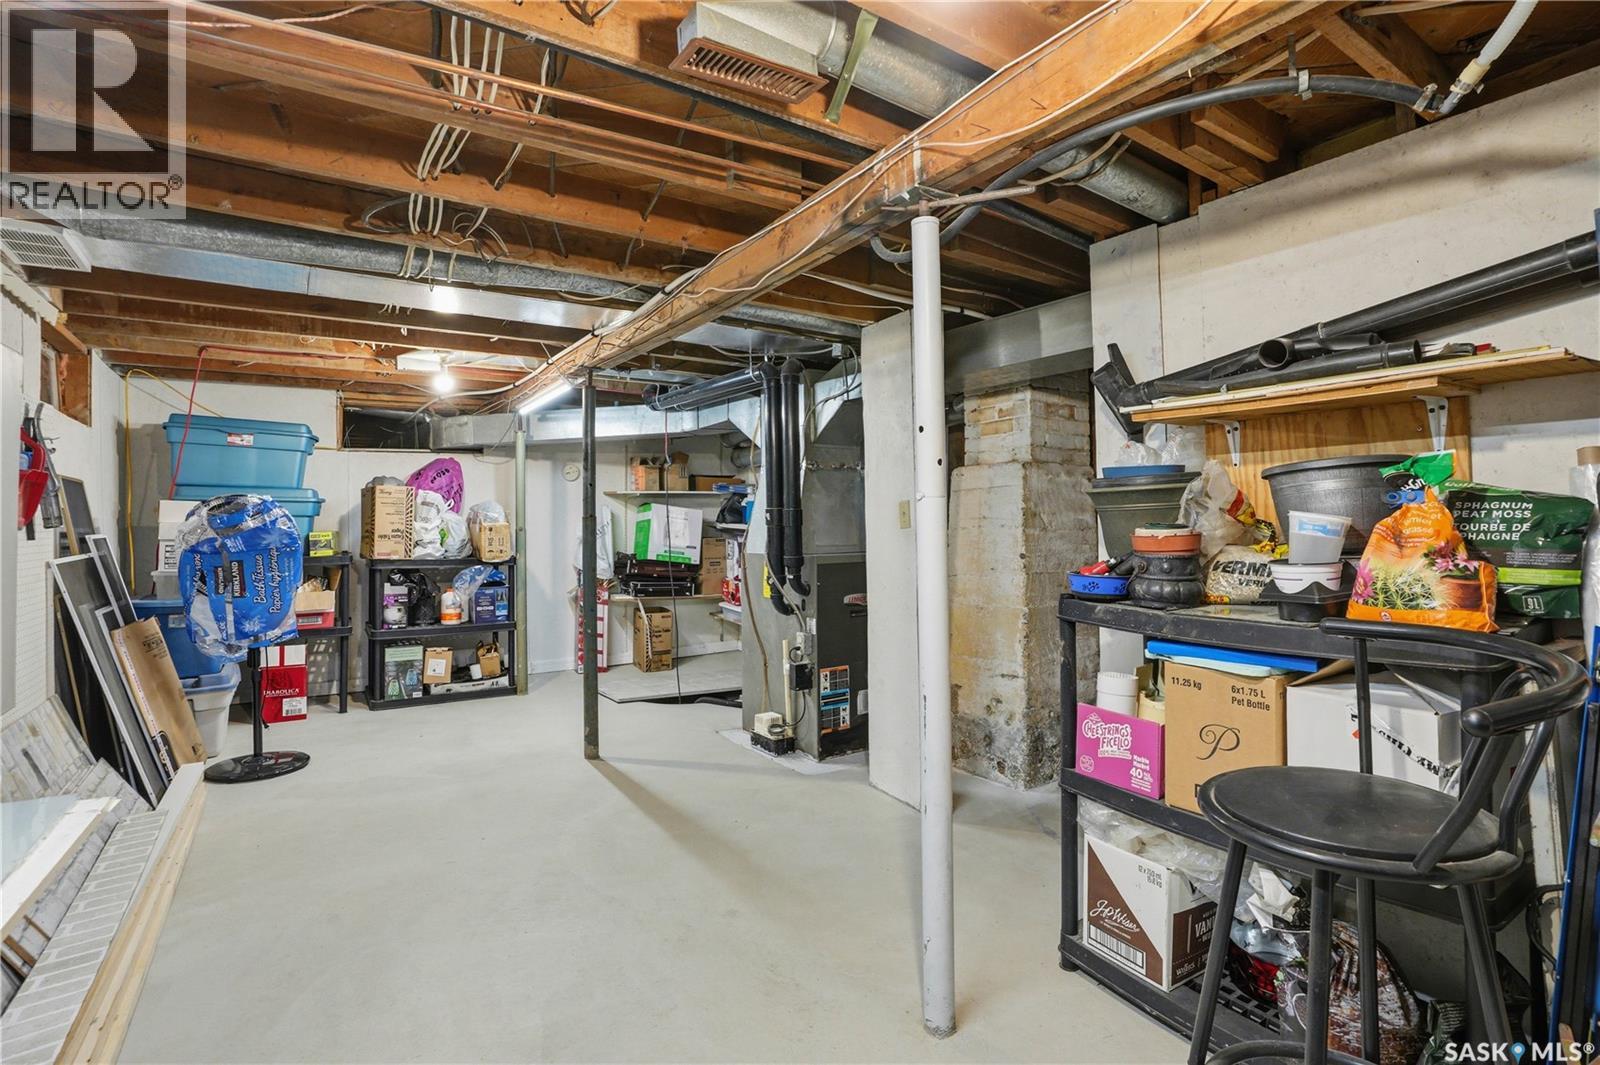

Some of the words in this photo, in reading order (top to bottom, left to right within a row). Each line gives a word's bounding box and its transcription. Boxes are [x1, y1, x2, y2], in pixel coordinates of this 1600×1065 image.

[1455, 501, 1533, 510] SPHAGNUM
[1454, 510, 1488, 518] PEAT
[1492, 510, 1532, 518] MOSS
[1454, 522, 1507, 532] TOURBE
[1512, 523, 1532, 532] DE
[1459, 532, 1520, 541] PHAIGNE
[252, 554, 264, 580] Tissue
[1211, 560, 1273, 578] VERMI
[231, 561, 240, 597] KIRKLAND
[253, 578, 267, 604] Bath
[269, 588, 282, 614] Papier
[1171, 676, 1192, 688] 11.25
[1193, 679, 1202, 691] kg
[1231, 685, 1259, 697] 6x1.75
[1260, 690, 1266, 699] L
[1231, 697, 1245, 707] Pet
[1246, 698, 1271, 711] Bottle
[1083, 720, 1131, 738] CHEESTRINGS
[1195, 723, 1241, 760] P
[1130, 766, 1143, 779] 40
